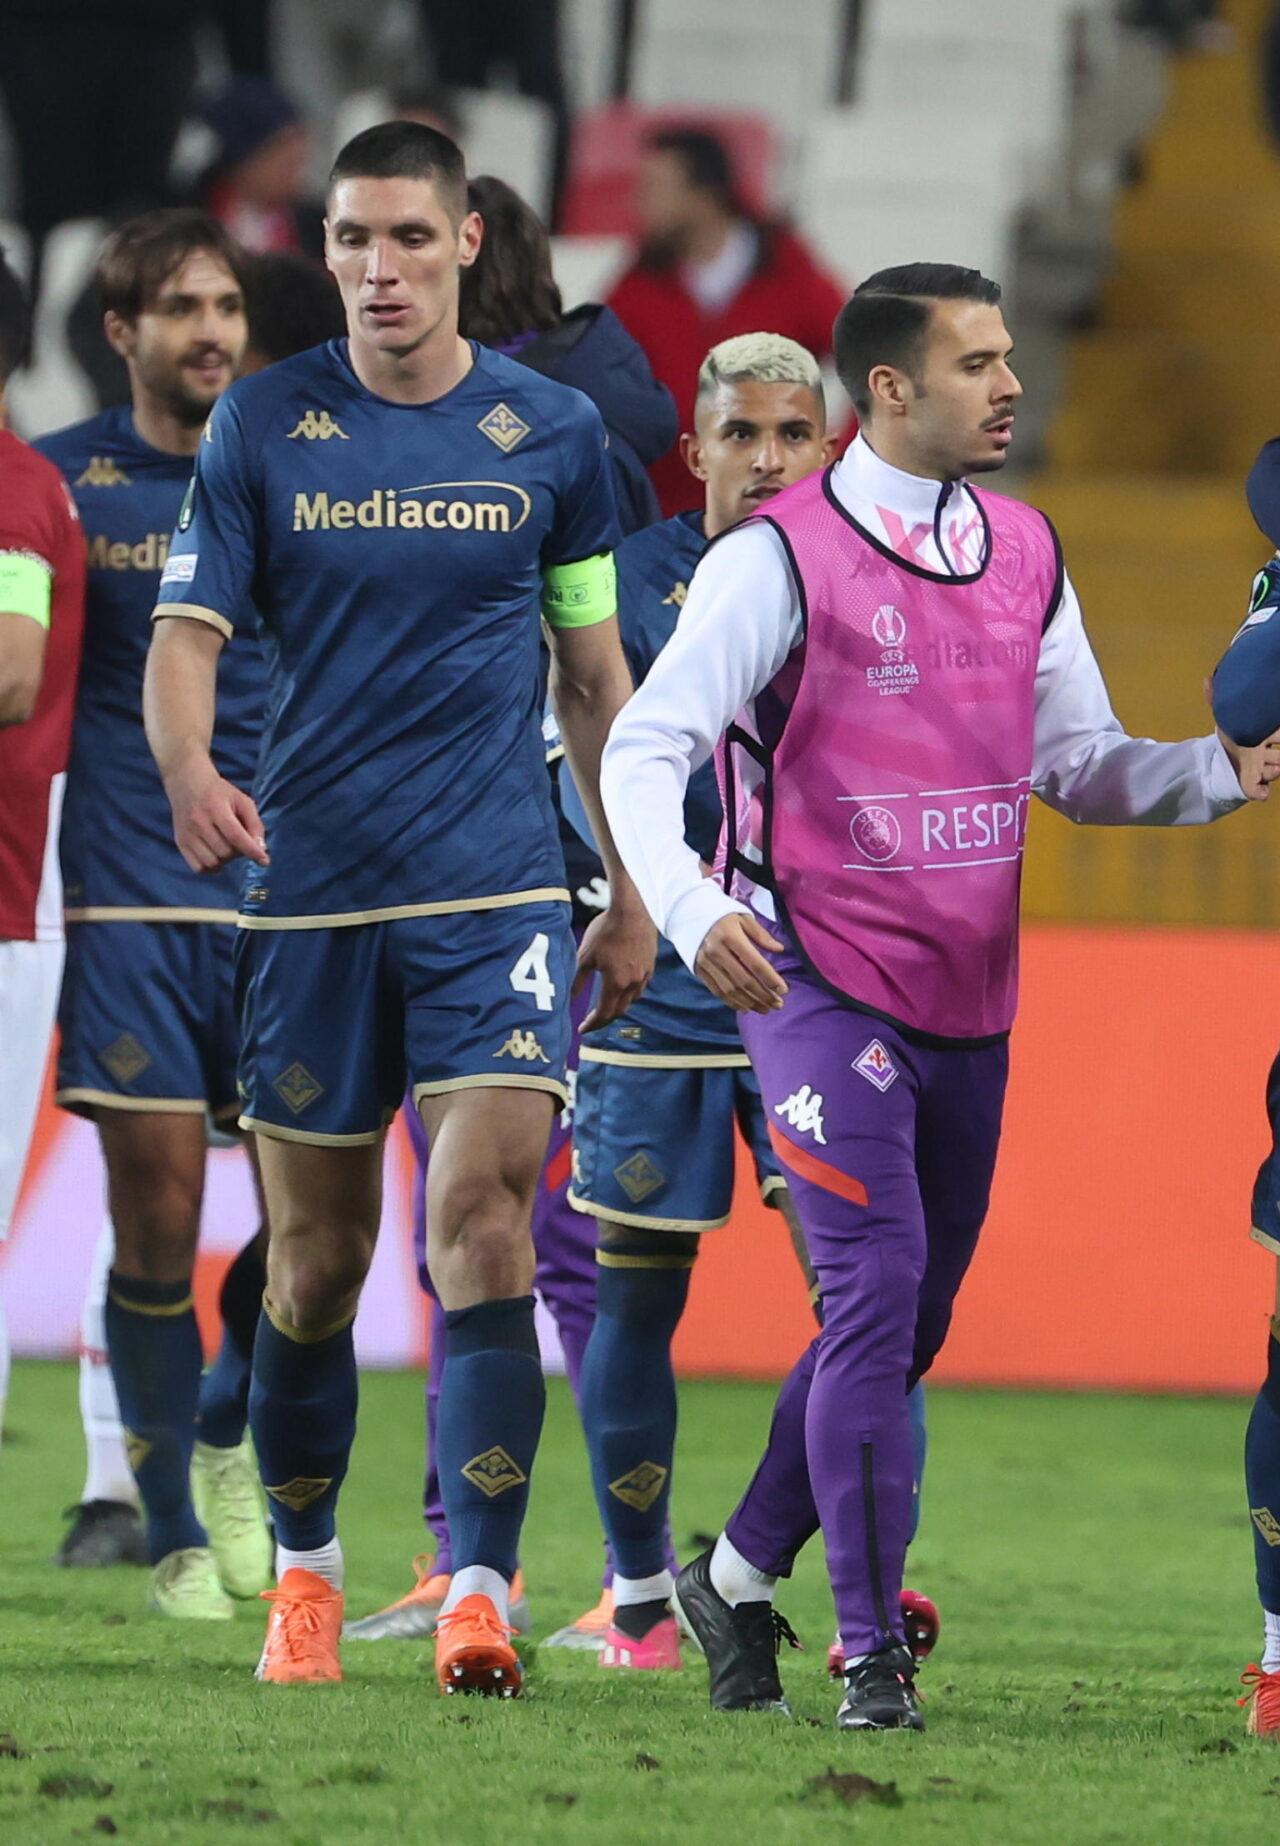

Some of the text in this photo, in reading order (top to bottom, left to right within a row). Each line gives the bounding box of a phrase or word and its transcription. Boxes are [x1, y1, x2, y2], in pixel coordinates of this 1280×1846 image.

[293, 488, 511, 532] Mediacom
[866, 663, 919, 679] EUROPA
[879, 685, 911, 696] LEAGUE
[858, 810, 889, 824] UEFA
[509, 932, 556, 1012] 4
